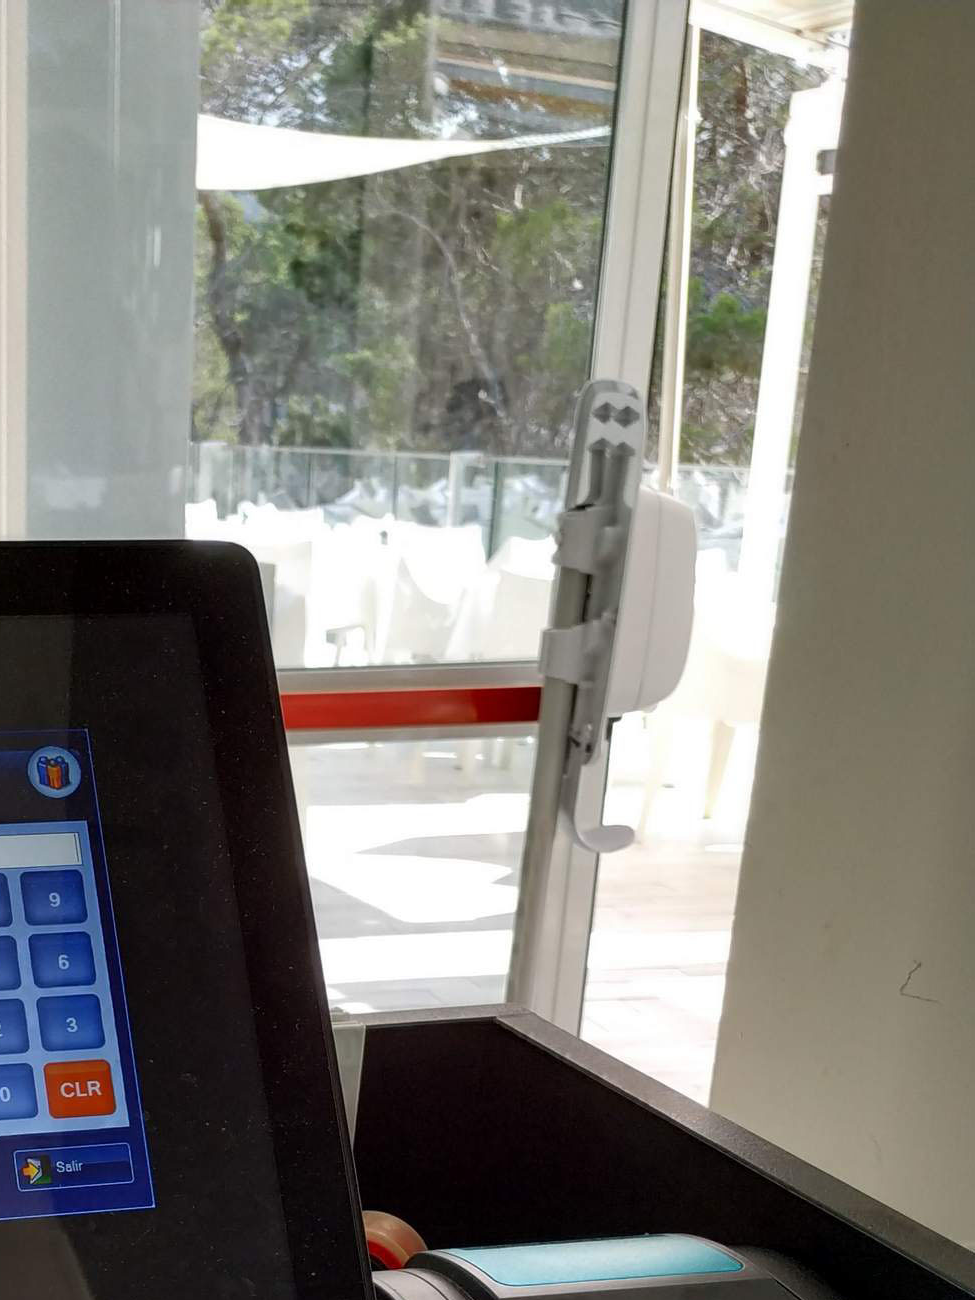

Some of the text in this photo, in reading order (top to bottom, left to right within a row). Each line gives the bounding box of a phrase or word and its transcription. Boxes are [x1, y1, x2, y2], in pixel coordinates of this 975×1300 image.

[49, 892, 61, 908] 9
[57, 955, 70, 970] 6
[66, 1018, 78, 1033] 3
[0, 1087, 11, 1102] 0
[60, 1079, 102, 1098] CLR
[55, 1159, 83, 1173] Salir
